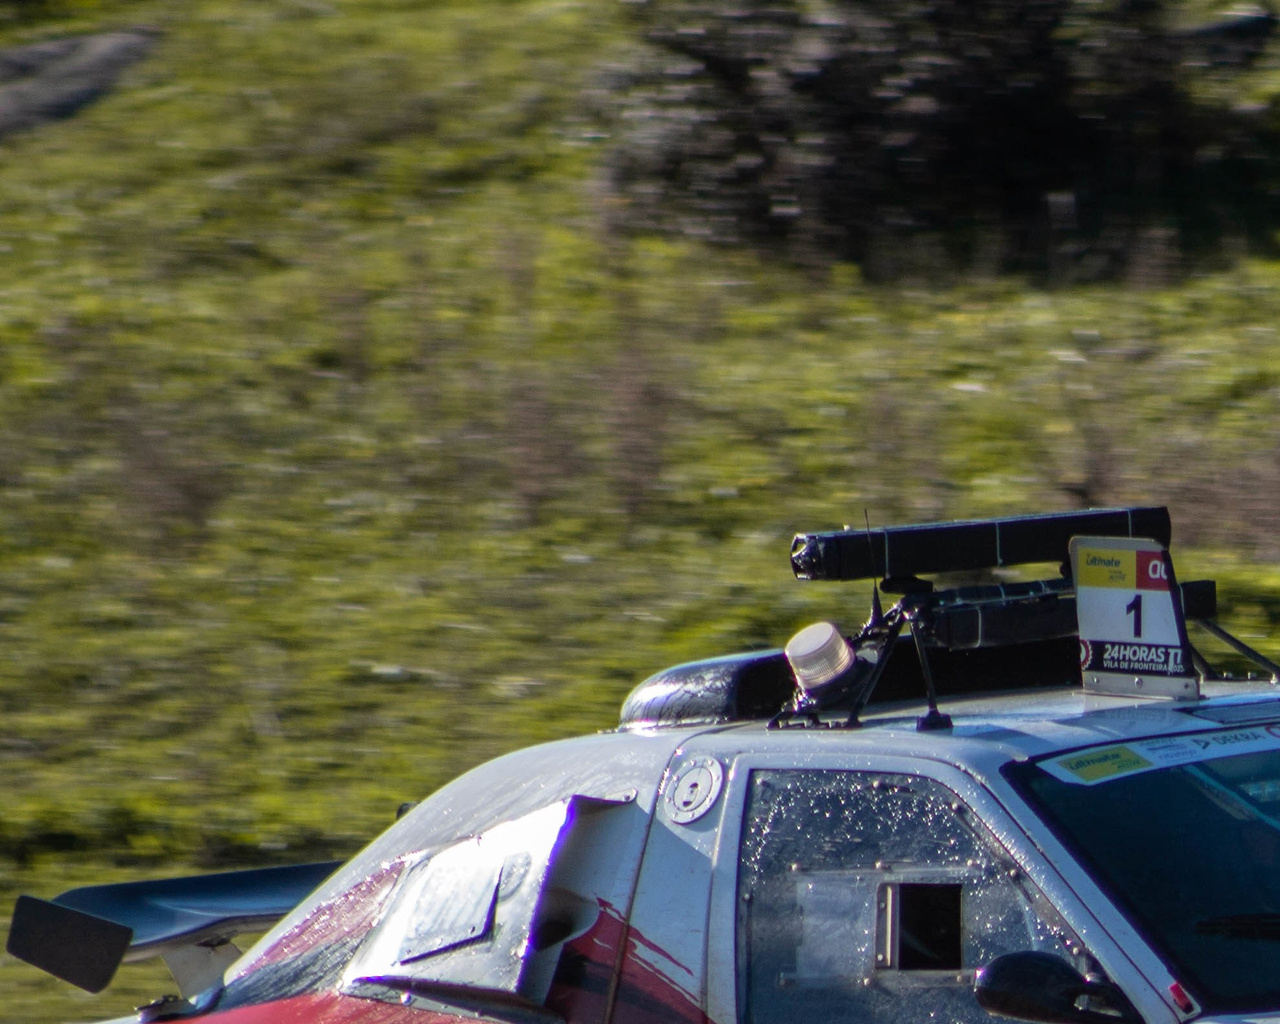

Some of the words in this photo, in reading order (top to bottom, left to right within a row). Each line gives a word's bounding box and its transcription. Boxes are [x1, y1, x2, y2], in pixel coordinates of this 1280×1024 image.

[1126, 594, 1142, 638] 1
[1103, 660, 1118, 669] VILA
[1120, 661, 1128, 669] DE
[1130, 662, 1168, 671] FRONTEIRA
[1212, 732, 1265, 746] DEKRA
